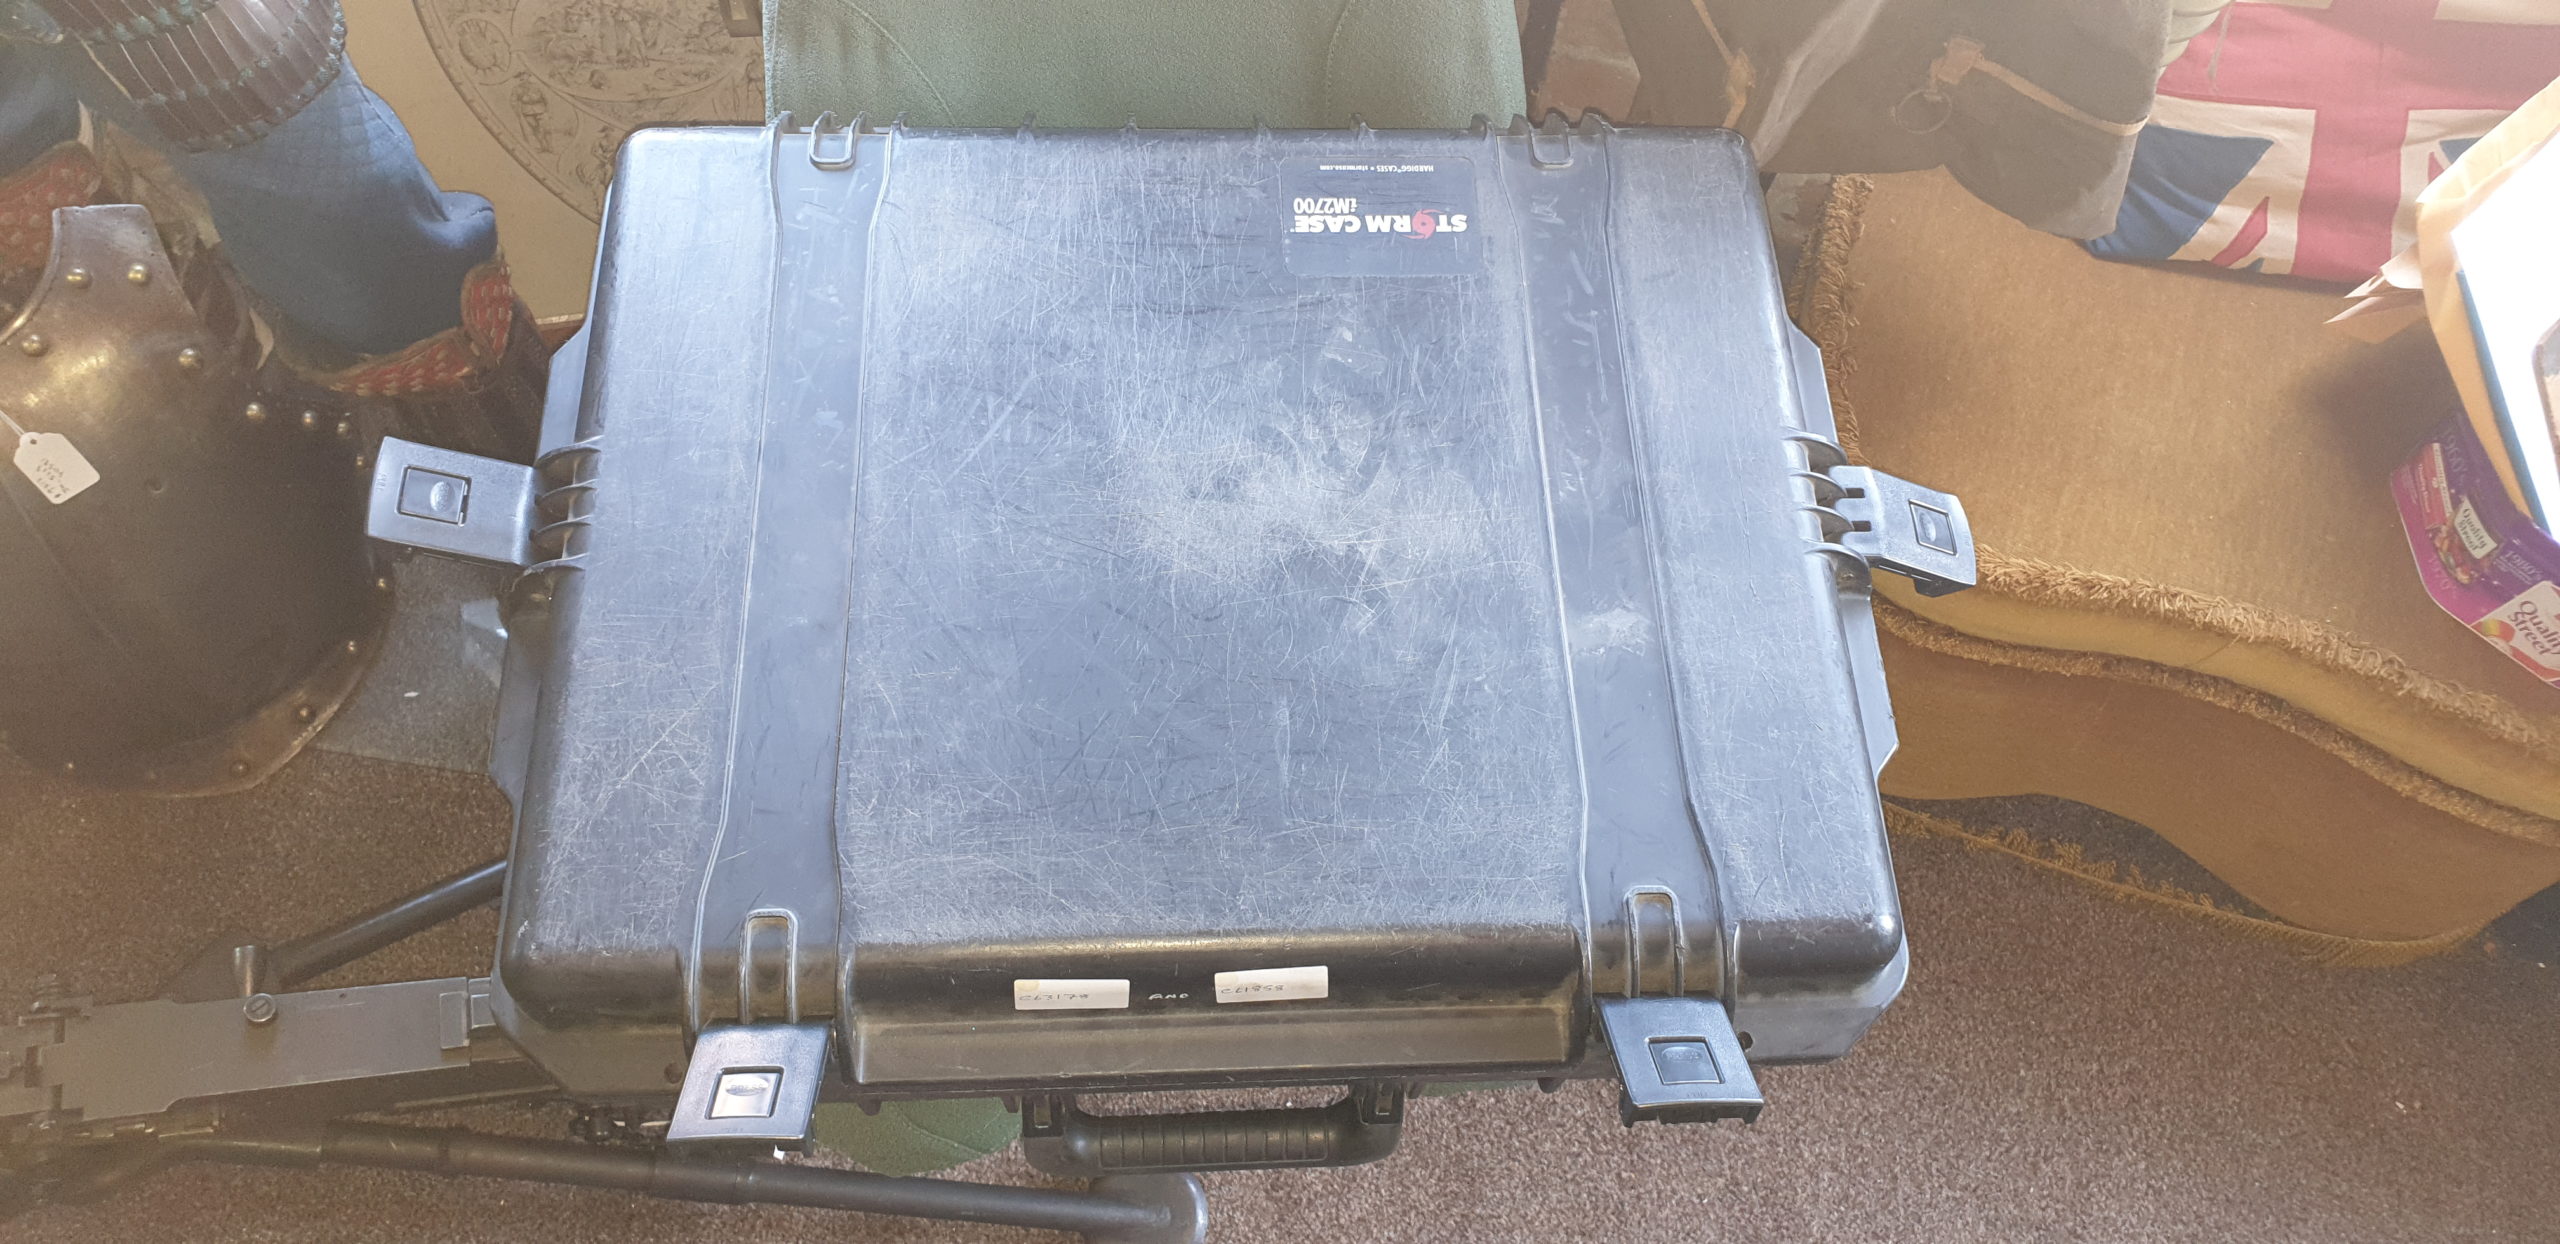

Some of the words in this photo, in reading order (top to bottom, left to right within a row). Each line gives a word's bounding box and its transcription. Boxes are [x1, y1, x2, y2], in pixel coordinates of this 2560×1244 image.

[1376, 164, 1398, 173] CASES
[1293, 197, 1358, 215] iM2700
[1293, 213, 1362, 233] CASE
[1364, 210, 1468, 237] STORM
[2507, 611, 2552, 656] Street
